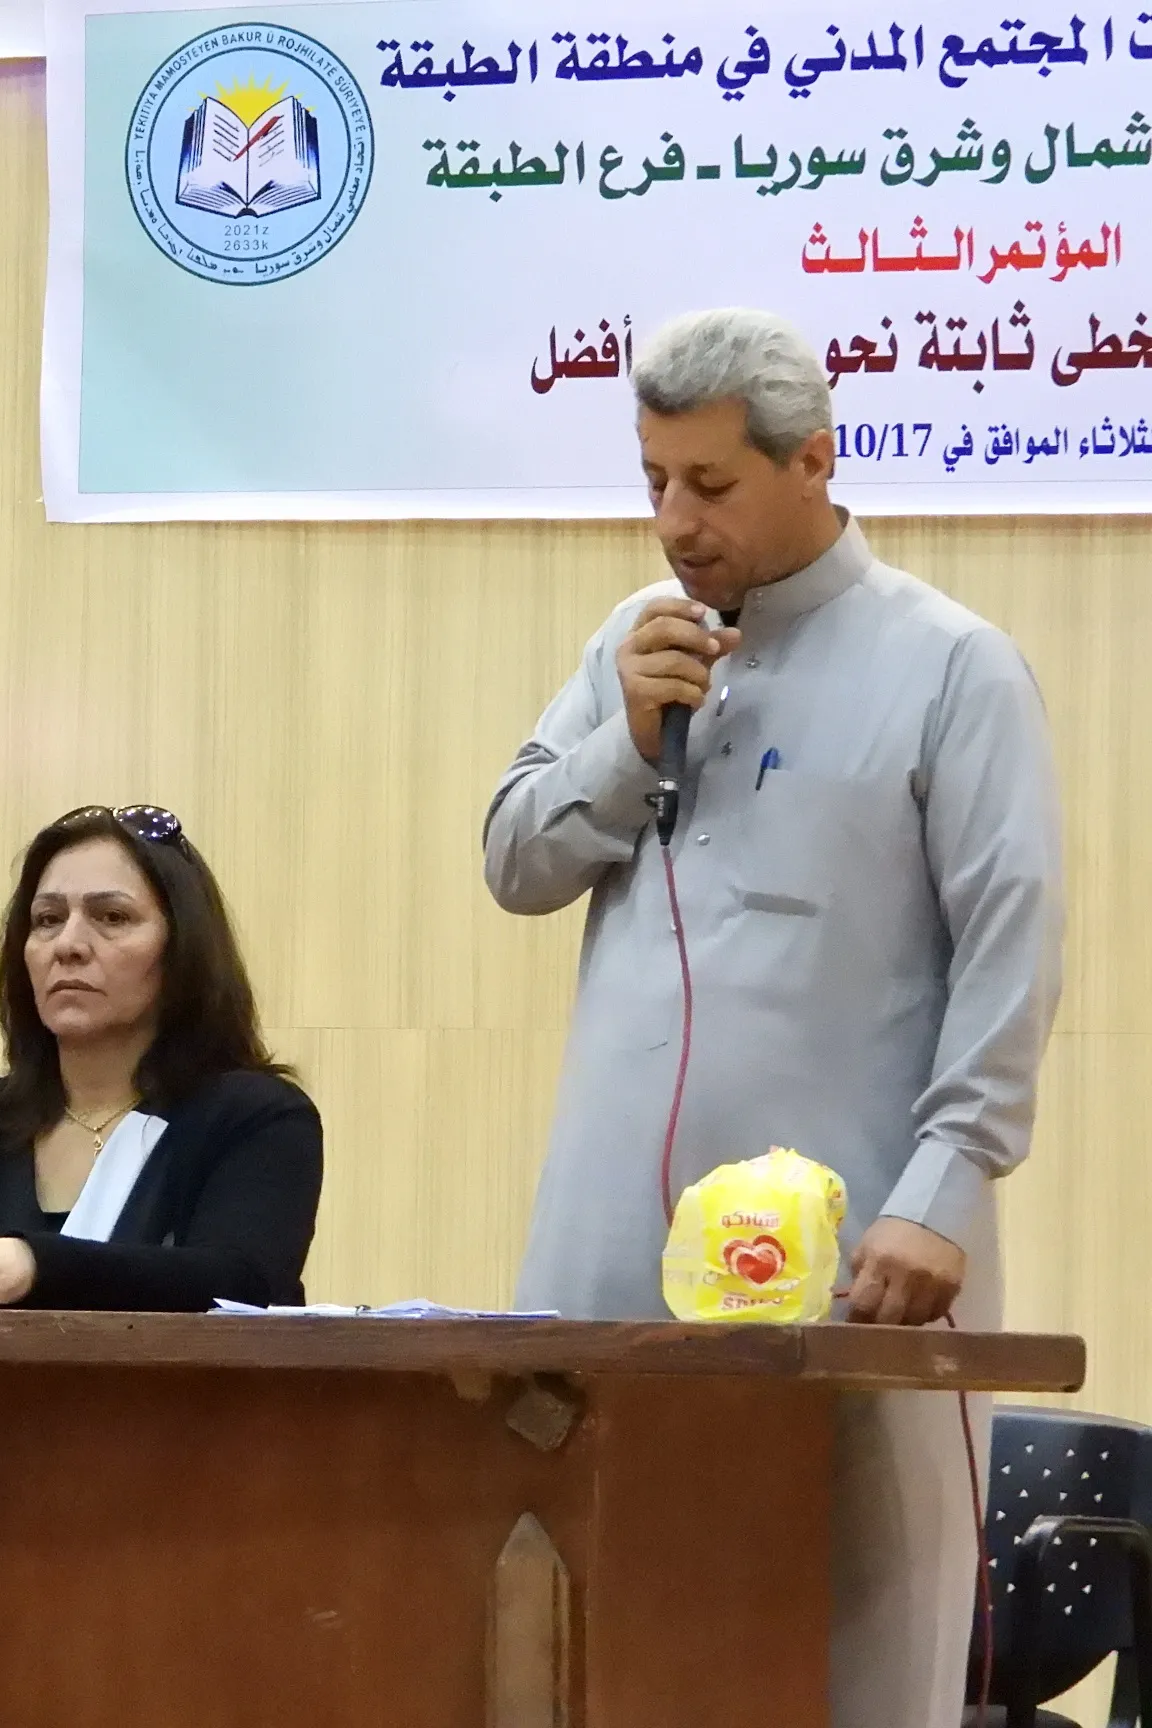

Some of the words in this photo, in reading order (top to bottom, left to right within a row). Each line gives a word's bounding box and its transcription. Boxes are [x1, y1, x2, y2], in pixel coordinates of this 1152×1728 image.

[221, 31, 262, 46] BAKUR
[376, 38, 538, 102] الطبقة
[551, 32, 704, 82] منطقة
[716, 26, 771, 102] في
[783, 22, 924, 100] المدني
[939, 14, 1113, 89] المجتمع
[421, 138, 585, 203] الطبقة
[598, 131, 686, 200] فرع
[733, 133, 866, 197] سوريا
[880, 117, 1012, 188] وشرق
[1024, 111, 1152, 185] شمال
[224, 225, 269, 236] 2021z
[224, 240, 269, 251] 2633k
[801, 215, 974, 274] الثالث
[976, 220, 1121, 285] المؤتمر
[254, 259, 290, 277] سوريا
[530, 313, 633, 395] أفضل
[825, 315, 898, 390] نحو
[913, 299, 1035, 394] ثابتة
[1050, 312, 1152, 387] خطى
[942, 424, 974, 473] في
[984, 423, 1069, 466] الموافق
[1079, 416, 1152, 459] ثلاثاء
